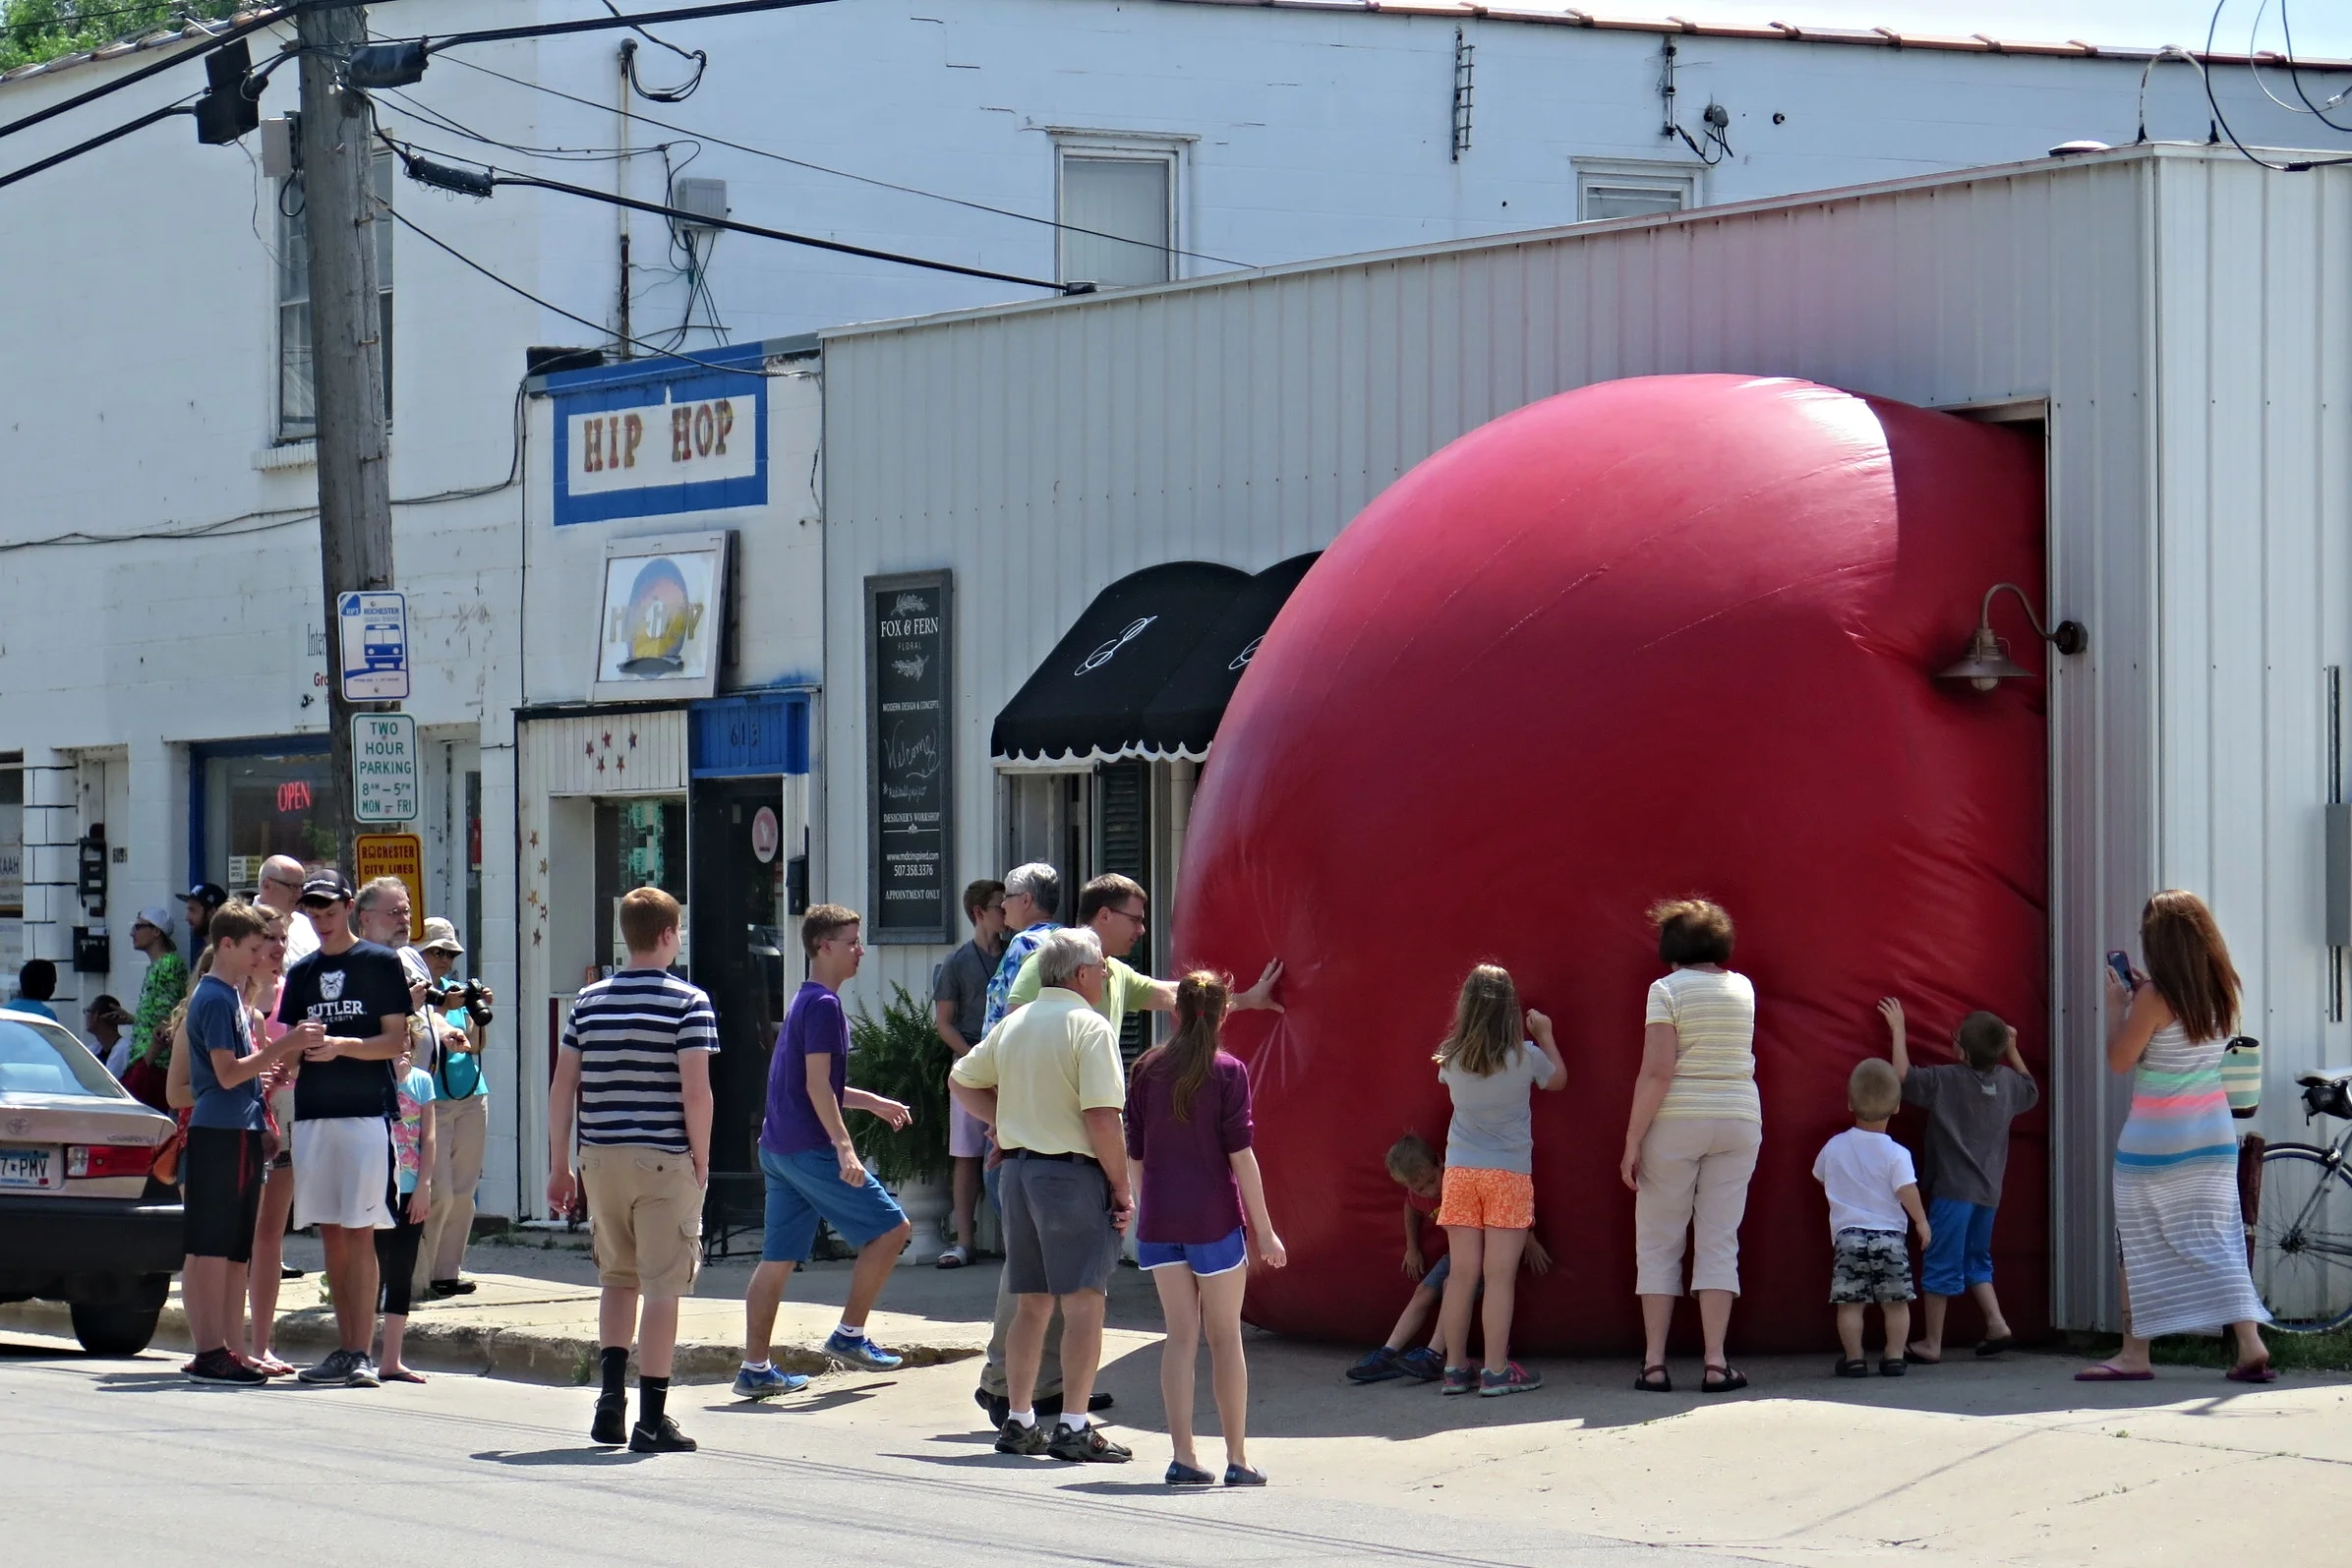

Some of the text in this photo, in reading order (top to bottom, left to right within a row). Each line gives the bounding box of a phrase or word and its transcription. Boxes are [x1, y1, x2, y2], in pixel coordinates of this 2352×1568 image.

[584, 399, 734, 472] HIP HOP
[363, 607, 399, 615] ROCHESTER
[881, 617, 938, 637] FOX & FERN
[897, 641, 921, 651] FLORAL
[882, 703, 901, 712] MODERN
[901, 701, 916, 711] DESIGN
[920, 699, 939, 709] CONCEPTS
[370, 722, 398, 735] TWO
[365, 741, 404, 755] HOUR
[359, 761, 411, 775] PARKING
[277, 781, 312, 812] OPEN
[362, 799, 381, 813] MON
[397, 799, 411, 813] FRI
[913, 812, 939, 822] WORKSHOP
[365, 864, 413, 875] CITY LINES
[894, 864, 933, 876] 507.358.3376
[885, 889, 940, 900] APPOINTMENT ONLY
[307, 1000, 364, 1019] BUTLER
[20, 1158, 46, 1177] PMV
